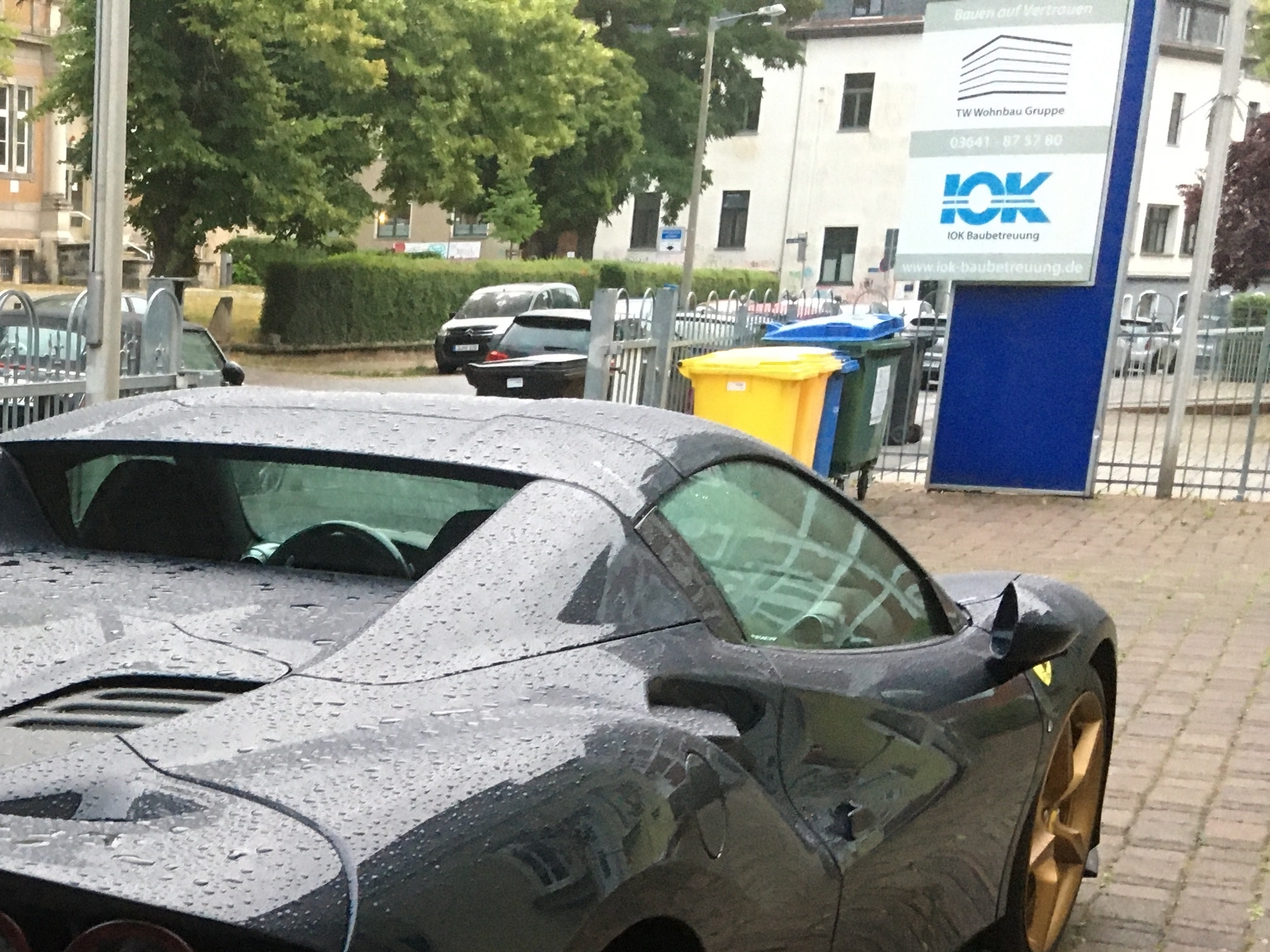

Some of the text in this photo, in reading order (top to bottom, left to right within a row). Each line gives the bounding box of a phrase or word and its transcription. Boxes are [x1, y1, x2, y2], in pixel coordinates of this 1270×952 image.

[954, 4, 1093, 21] Bauen auf Vertrauen
[956, 106, 1065, 118] TW Wohnbau Gruppe
[949, 136, 990, 149] 03641
[1002, 134, 1021, 148] 87
[1044, 133, 1063, 147] 80
[966, 231, 1040, 242] Baubetreuung
[902, 260, 1084, 276] www.iok-baubetreuung.de
